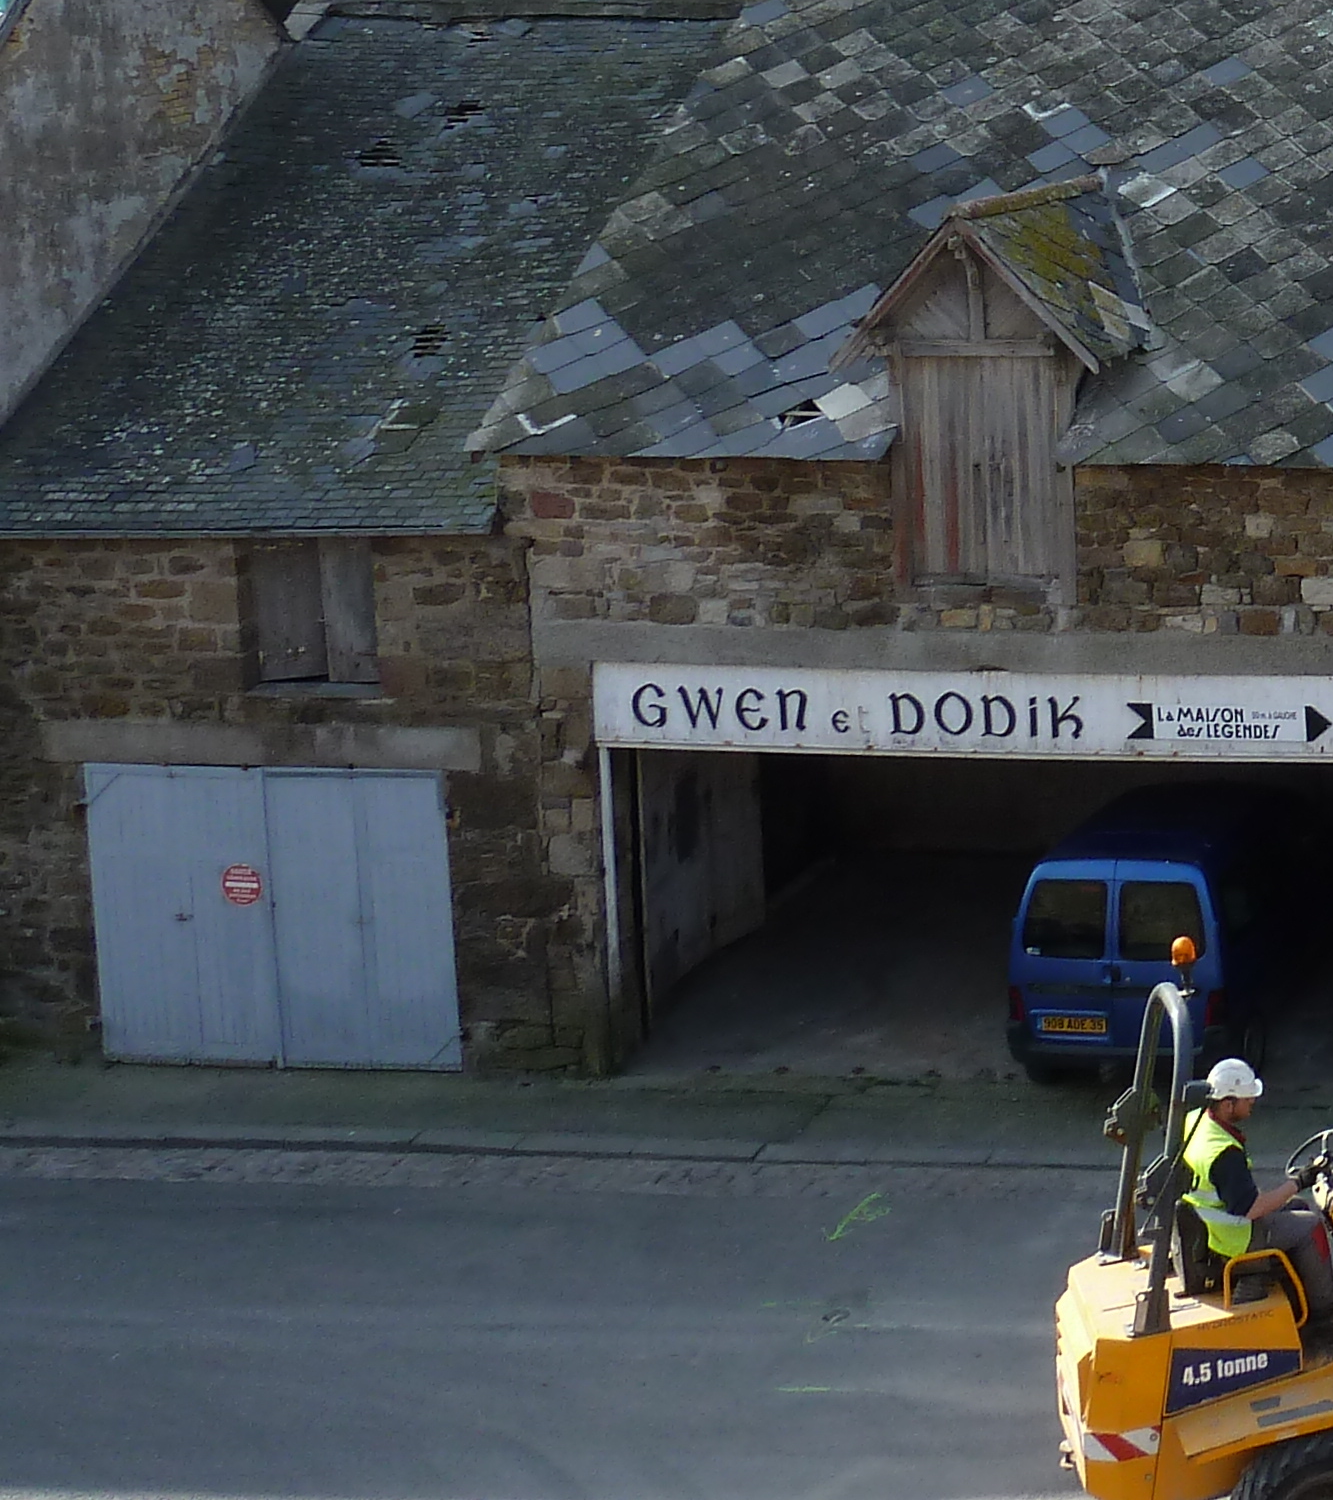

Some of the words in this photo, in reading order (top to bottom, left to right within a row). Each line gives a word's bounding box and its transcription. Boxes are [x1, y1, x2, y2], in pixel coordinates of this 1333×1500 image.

[632, 682, 808, 732] GWEN
[1157, 707, 1175, 722] La
[1177, 707, 1244, 723] MAISON
[1177, 723, 1203, 738] des
[1182, 1361, 1212, 1387] 4.5
[1217, 1352, 1269, 1379] tonne
